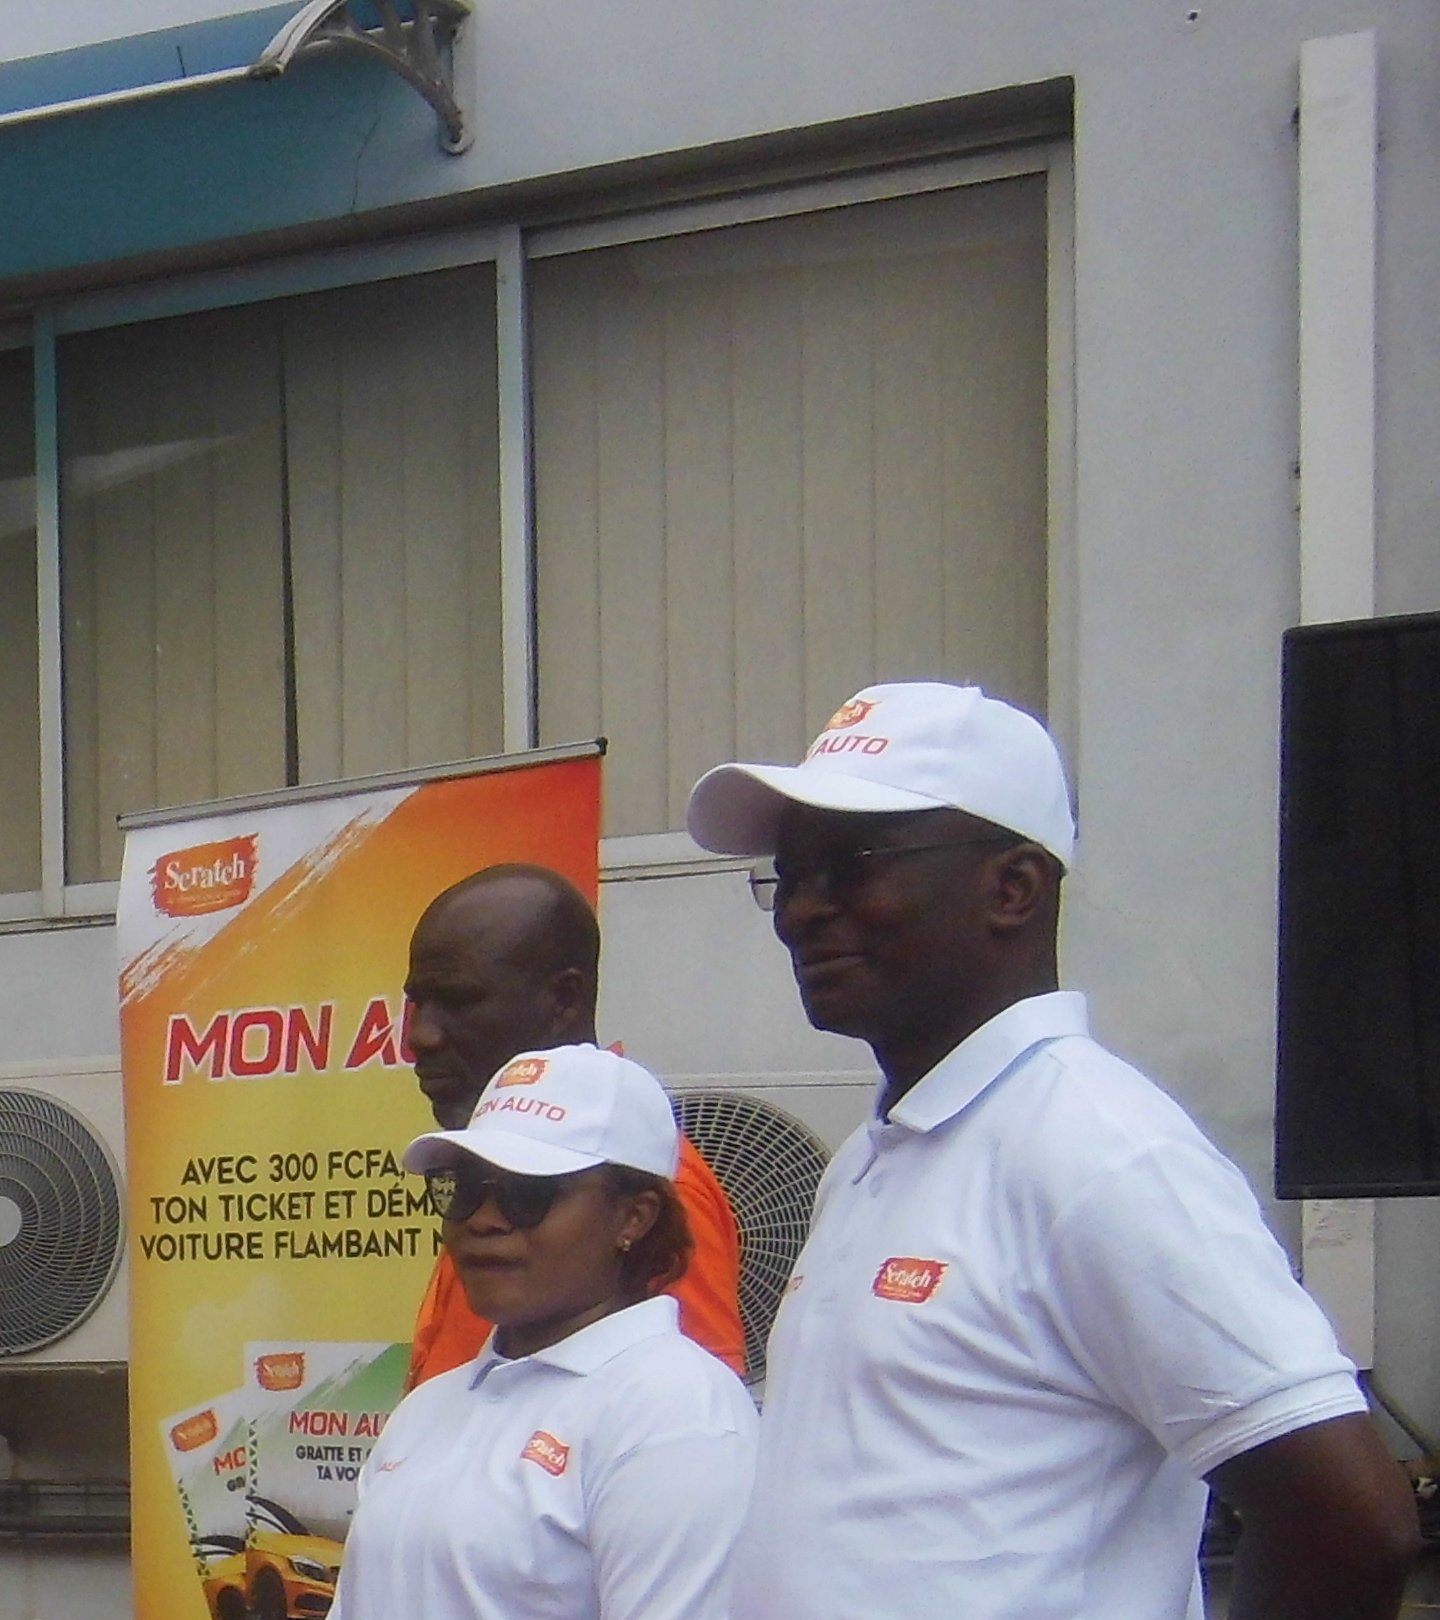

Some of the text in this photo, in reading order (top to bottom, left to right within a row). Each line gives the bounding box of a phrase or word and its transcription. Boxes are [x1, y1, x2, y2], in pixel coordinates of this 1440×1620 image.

[164, 853, 246, 891] Scratch
[165, 1003, 334, 1084] MON
[500, 1096, 566, 1121] AUTO
[181, 1149, 406, 1186] AVEC 300 FCFA,
[150, 1196, 208, 1225] TON
[218, 1191, 315, 1222] TICKET
[324, 1190, 357, 1220] ET
[139, 1231, 264, 1262] VOITURE
[274, 1227, 422, 1260] FLAMBANT
[289, 1411, 347, 1436] MON
[295, 1445, 344, 1462] GRATTE
[348, 1446, 363, 1462] ET
[317, 1465, 333, 1481] TA
